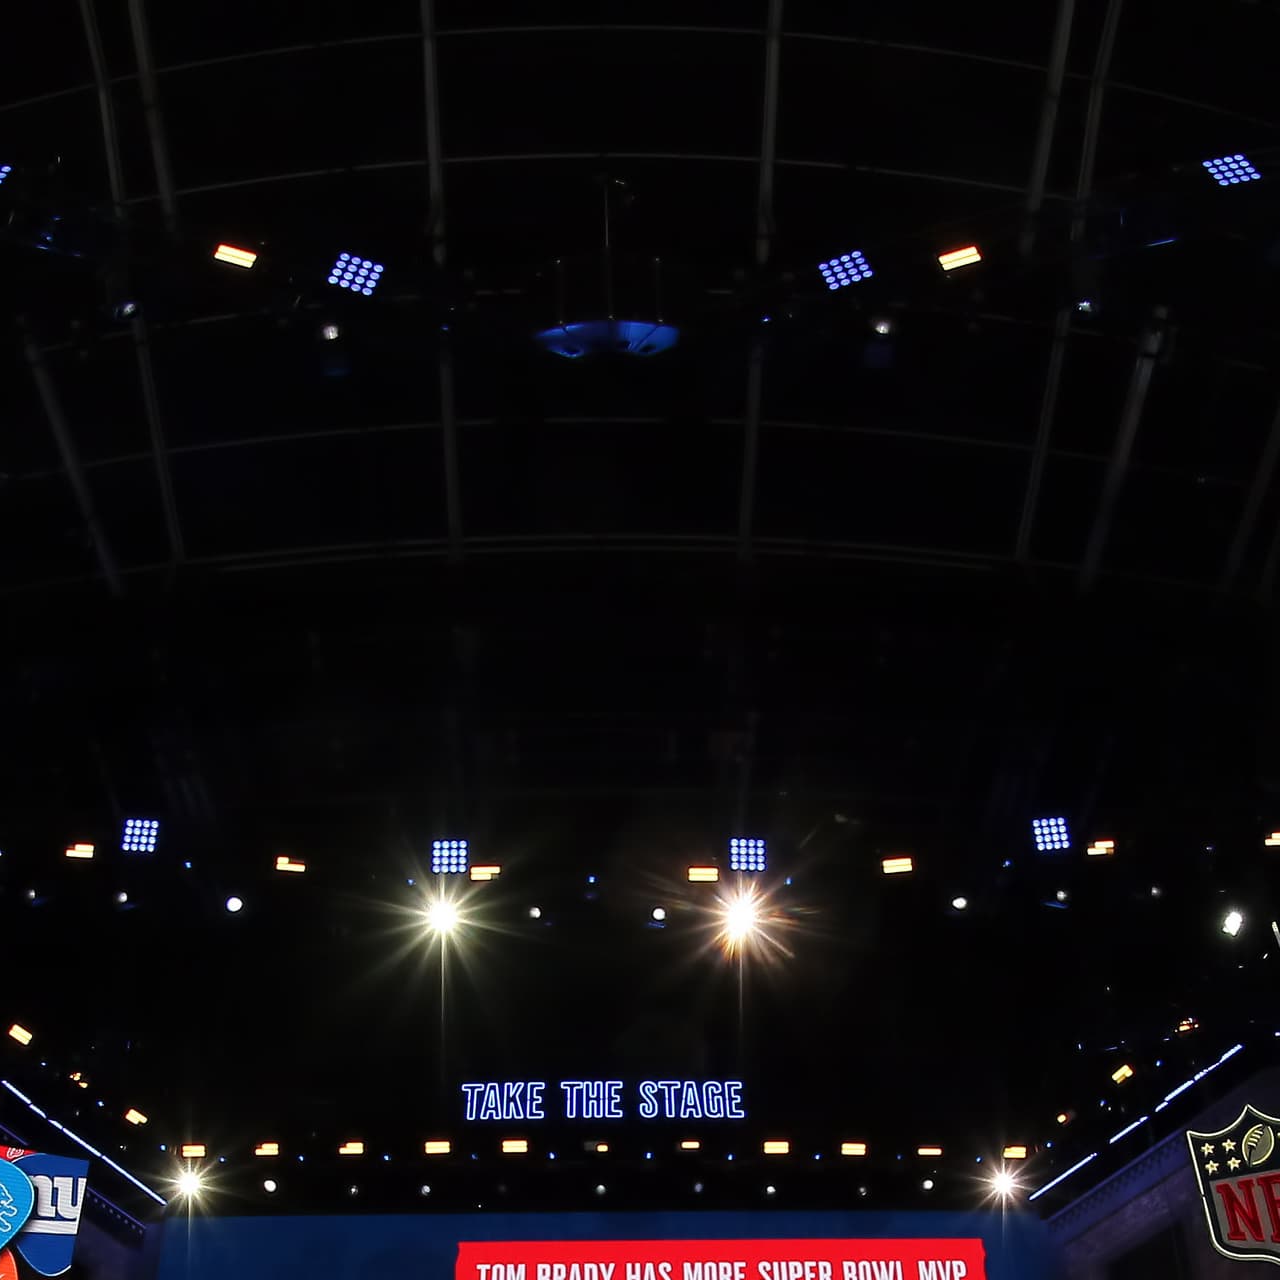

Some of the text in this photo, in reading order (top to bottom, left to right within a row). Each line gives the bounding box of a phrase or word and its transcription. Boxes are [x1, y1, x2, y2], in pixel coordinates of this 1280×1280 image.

[461, 1080, 746, 1121] TAKE THE STAGE
